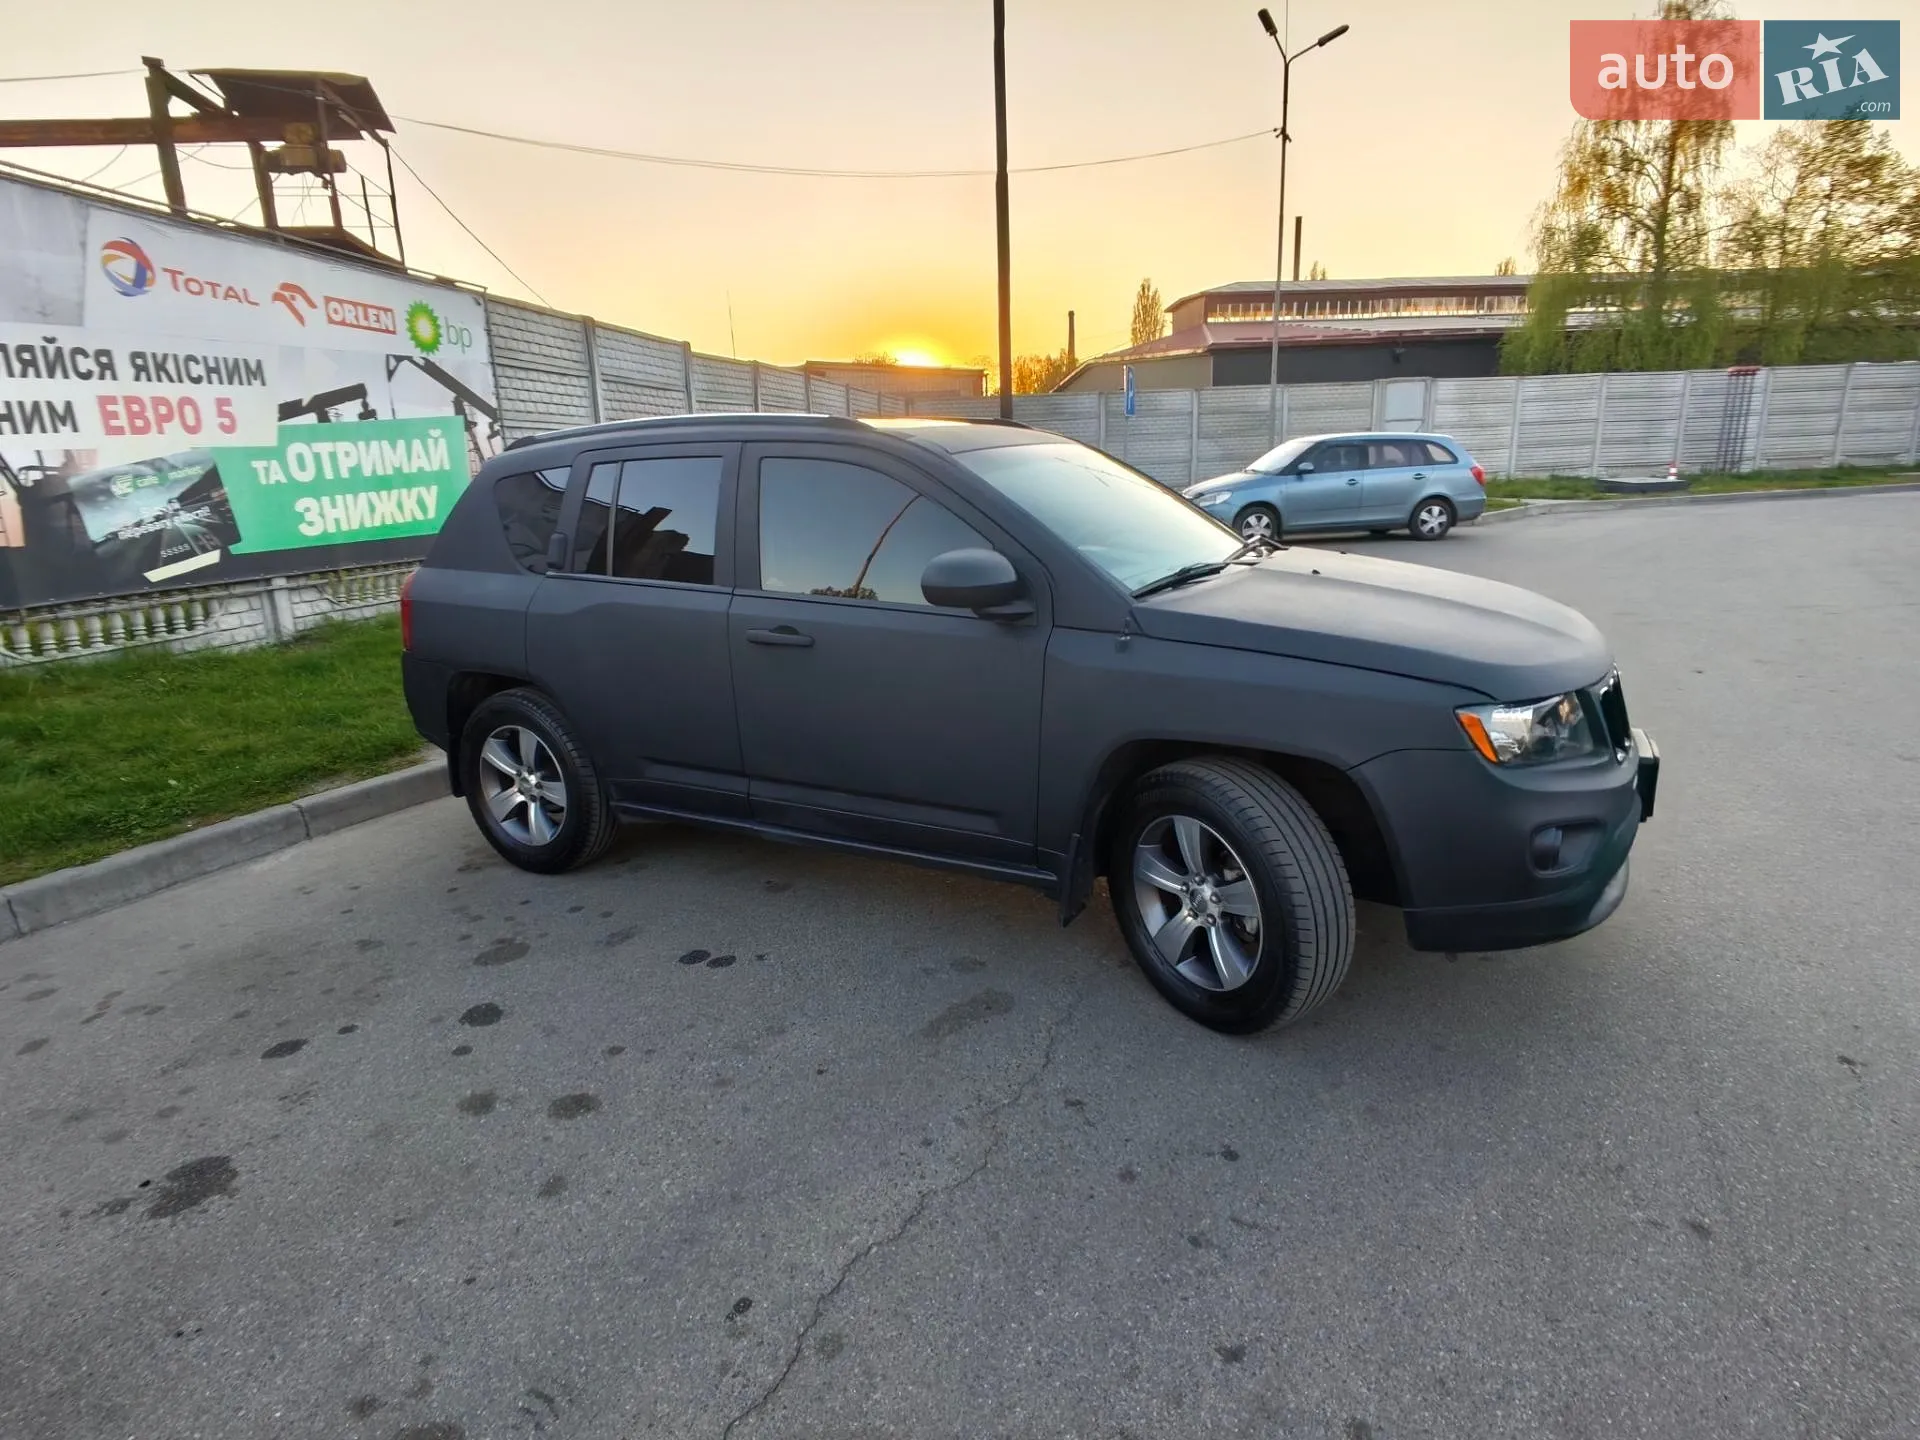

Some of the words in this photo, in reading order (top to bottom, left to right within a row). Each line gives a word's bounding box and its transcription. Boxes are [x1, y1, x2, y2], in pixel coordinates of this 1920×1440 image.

[162, 267, 260, 307] TOTAL
[326, 300, 395, 332] ORLEN
[444, 315, 473, 352] bp
[128, 350, 267, 386] ЯКІСНИМ
[96, 395, 203, 436] ЕВРО
[214, 397, 238, 435] 5
[251, 459, 288, 485] ТА
[286, 428, 450, 483] ОТРИМАЙ
[294, 485, 438, 537] ЗНИЖКУ
